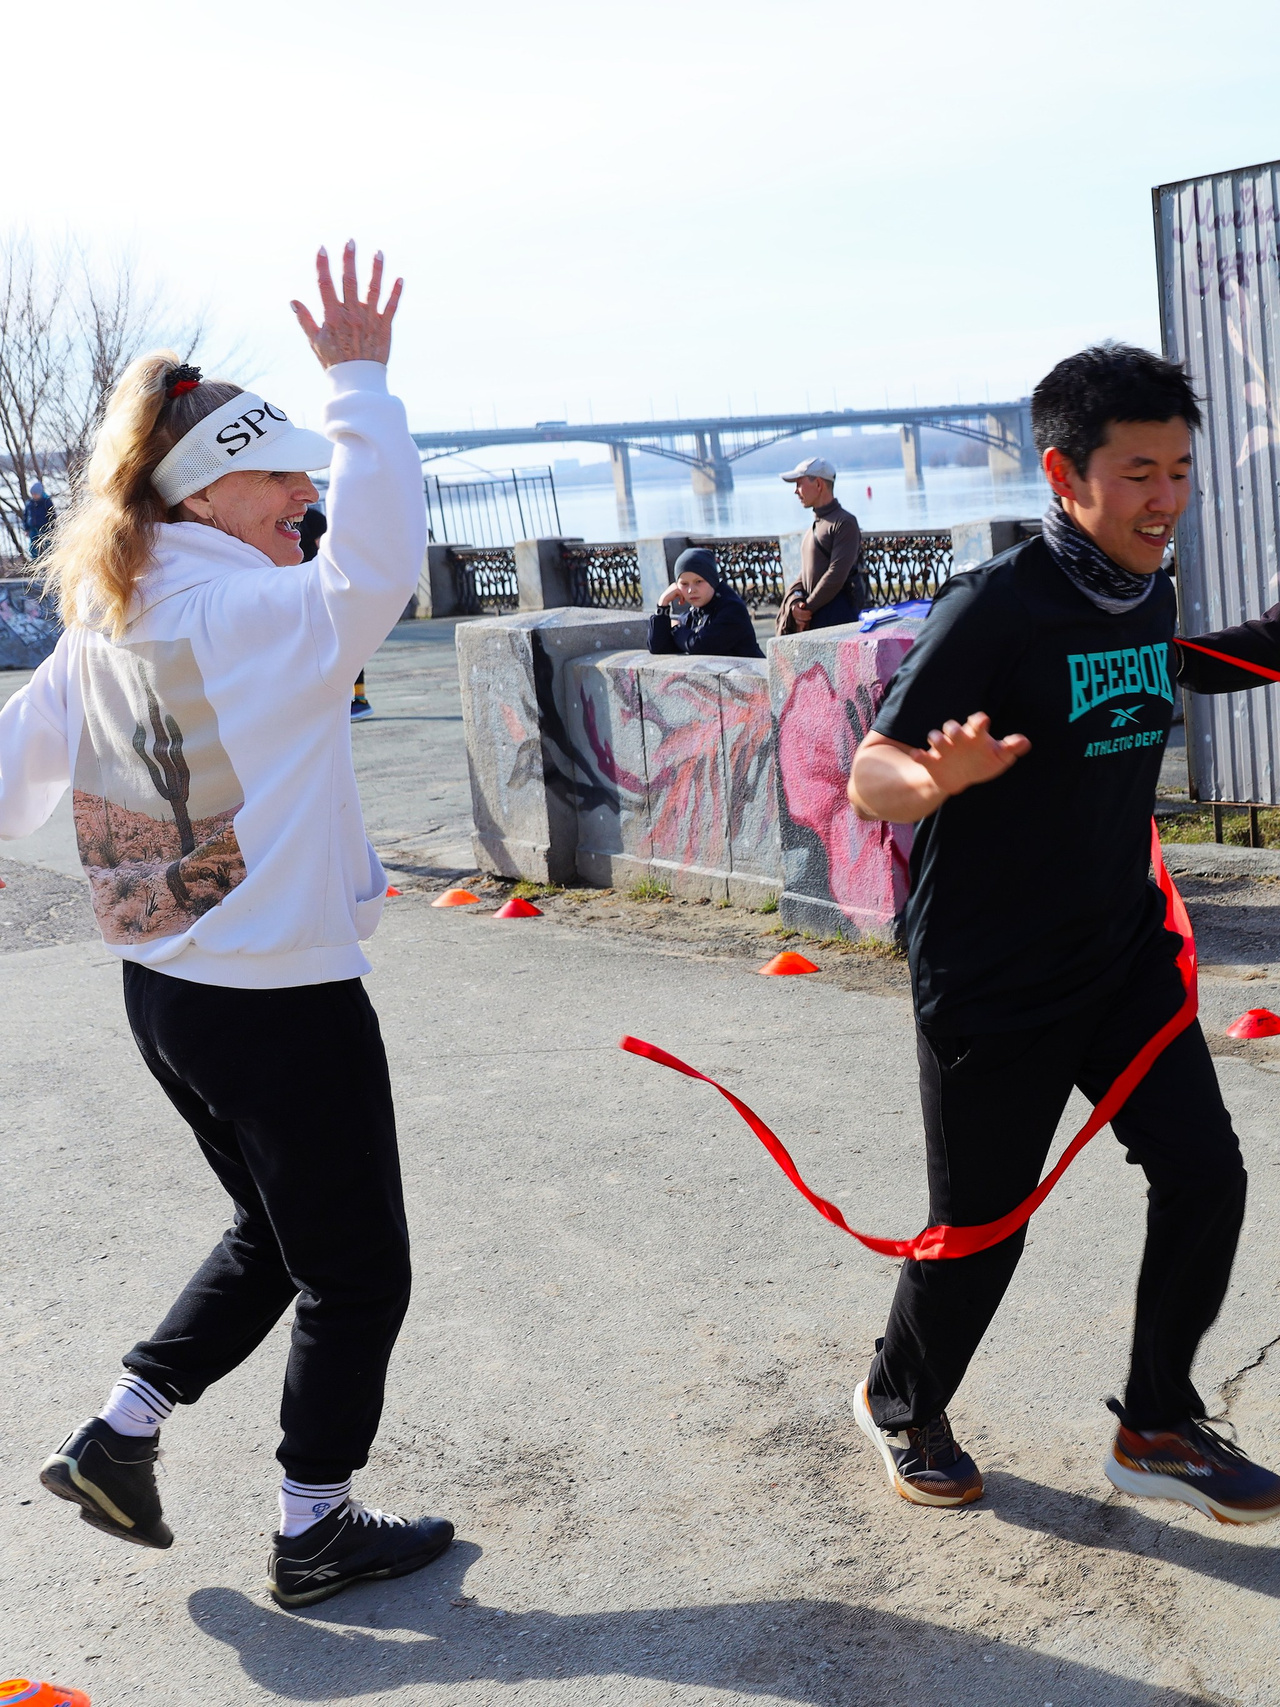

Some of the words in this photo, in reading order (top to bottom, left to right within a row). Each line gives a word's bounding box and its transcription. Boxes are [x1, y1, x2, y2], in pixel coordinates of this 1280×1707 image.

[1067, 642, 1175, 723] REEBOK
[1084, 735, 1134, 758] ATHLETIC
[1135, 730, 1164, 748] DEPT.
